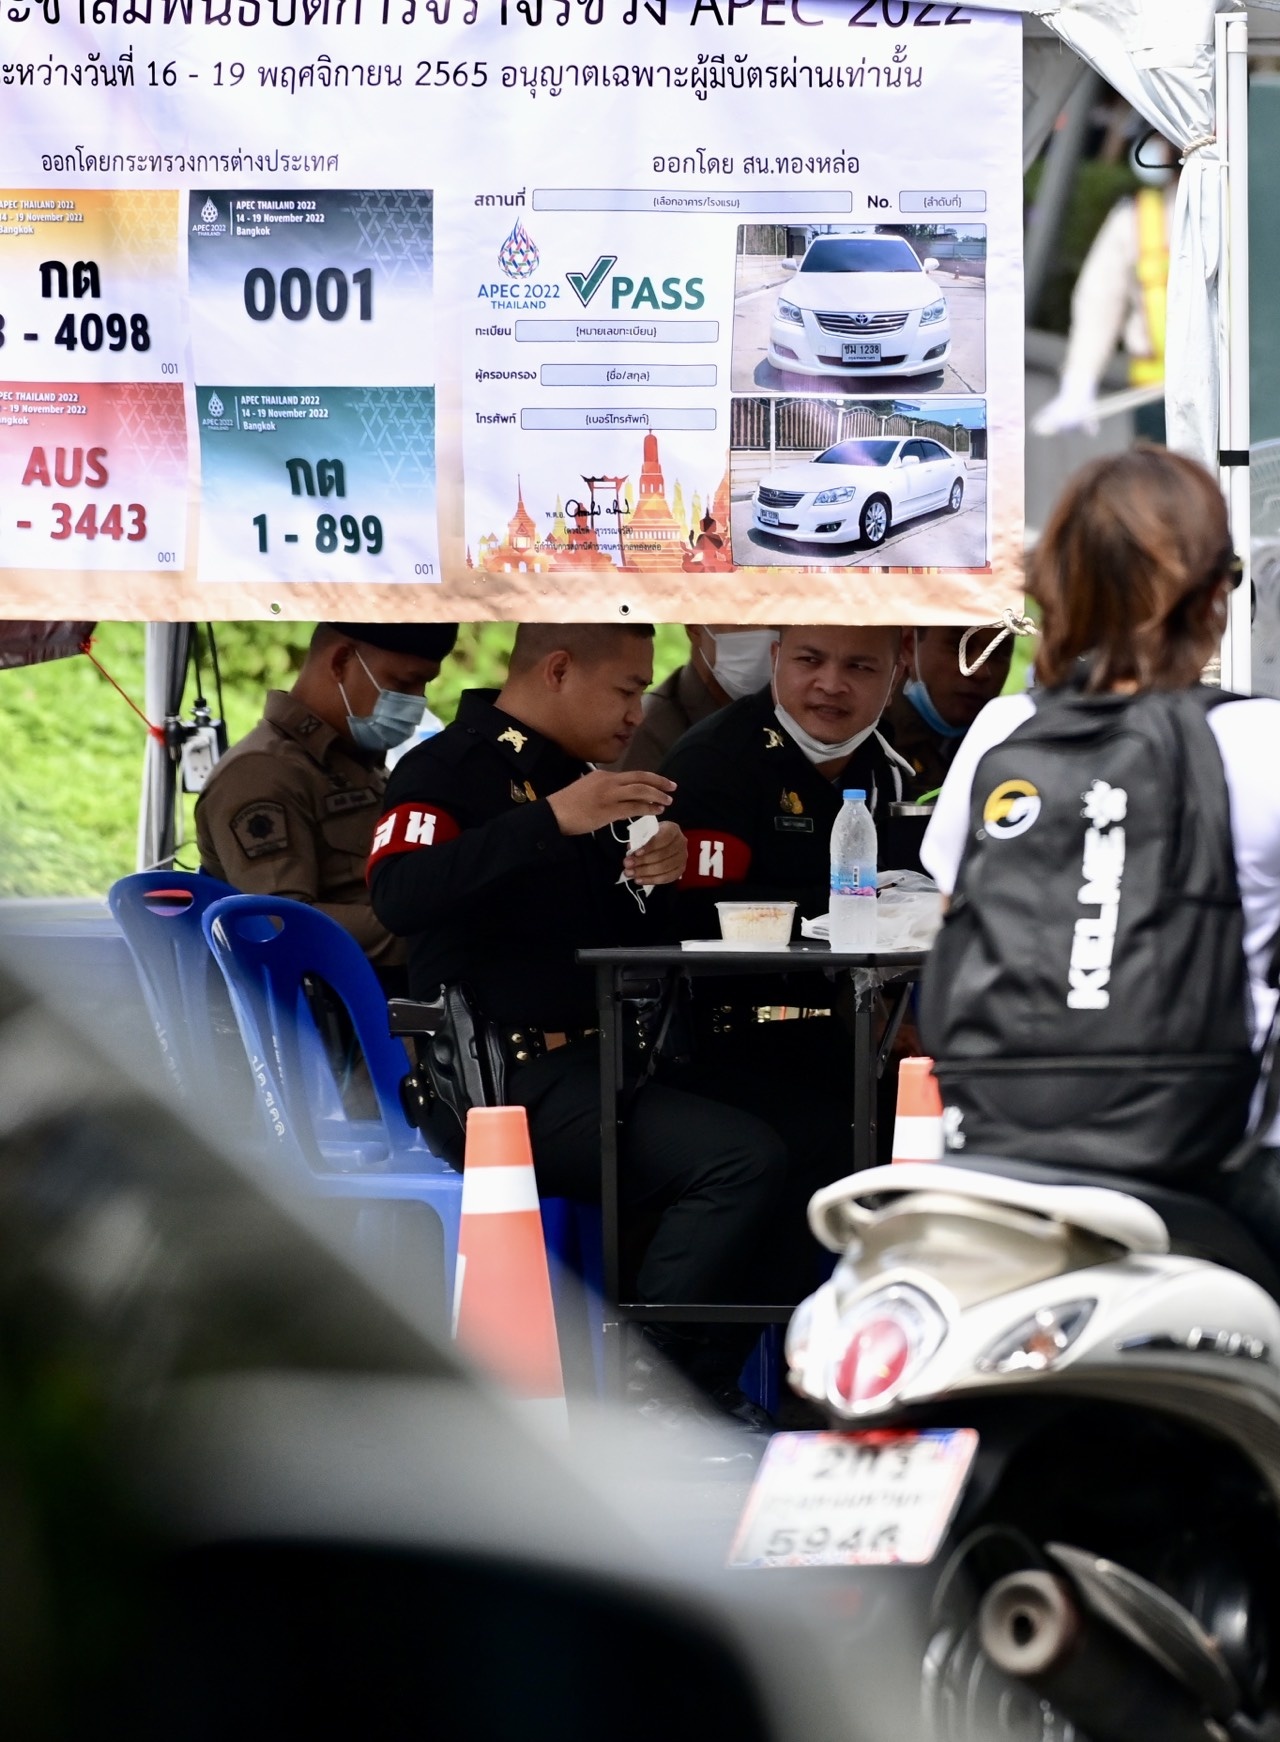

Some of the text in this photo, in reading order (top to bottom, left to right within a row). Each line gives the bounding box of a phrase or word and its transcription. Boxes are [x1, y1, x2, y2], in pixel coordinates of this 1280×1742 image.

[690, 0, 824, 26] APEC
[148, 61, 177, 86] 16
[213, 62, 245, 87] 19
[258, 54, 402, 95] พฤศจิกายน
[415, 61, 488, 87] 2565
[501, 44, 922, 100] อนุญาตเฉพาะผู้มีบัตรผ่านเท่านั้น
[41, 146, 339, 172] ออกโดยกระทรวงการต่างประเทศ
[652, 148, 860, 174] ออกโดย สน.ทองหล่อ
[474, 187, 526, 207] สถานที่
[867, 195, 893, 209] No.
[20, 200, 55, 209] THAILAND
[57, 200, 75, 209] 2022
[236, 201, 316, 210] APEC THAILAND 2022
[16, 213, 24, 222] 19
[26, 213, 63, 222] November
[66, 213, 83, 222] 2022
[236, 214, 245, 222] 14
[252, 214, 262, 222] 19
[263, 214, 303, 223] November
[305, 214, 325, 223] 2022
[192, 224, 226, 232] APEC 2022
[236, 226, 271, 238] Bangkok
[39, 260, 101, 299] กต
[244, 267, 372, 322] 0001
[477, 284, 560, 299] APEC 2022
[611, 277, 706, 310] PASS
[491, 300, 547, 310] THAILAND
[54, 313, 151, 352] 4098
[475, 325, 511, 337] ทะเบียน
[860, 345, 879, 354] 1238
[161, 363, 179, 374] 001
[475, 368, 537, 382] ผู้ครอบครอง
[0, 392, 79, 402] PEC THAILAND 2022
[241, 396, 320, 405] APEC THAILAND 2022
[9, 405, 20, 413] 19
[22, 405, 64, 414] November
[66, 405, 87, 414] 2022
[242, 409, 251, 417] 14
[257, 409, 267, 418] 19
[268, 409, 307, 418] November
[308, 409, 329, 418] 2022
[0, 416, 29, 426] angkok
[476, 412, 516, 424] โทรศัพท์
[243, 421, 276, 432] Bangkok
[21, 446, 109, 488] AUS
[286, 458, 346, 497] กต
[50, 503, 148, 541] 3443
[253, 513, 268, 553] 1
[315, 513, 384, 555] 899
[157, 552, 176, 562] 001
[414, 564, 434, 575] 001
[699, 840, 724, 879] ห
[1067, 826, 1126, 1009] KELME
